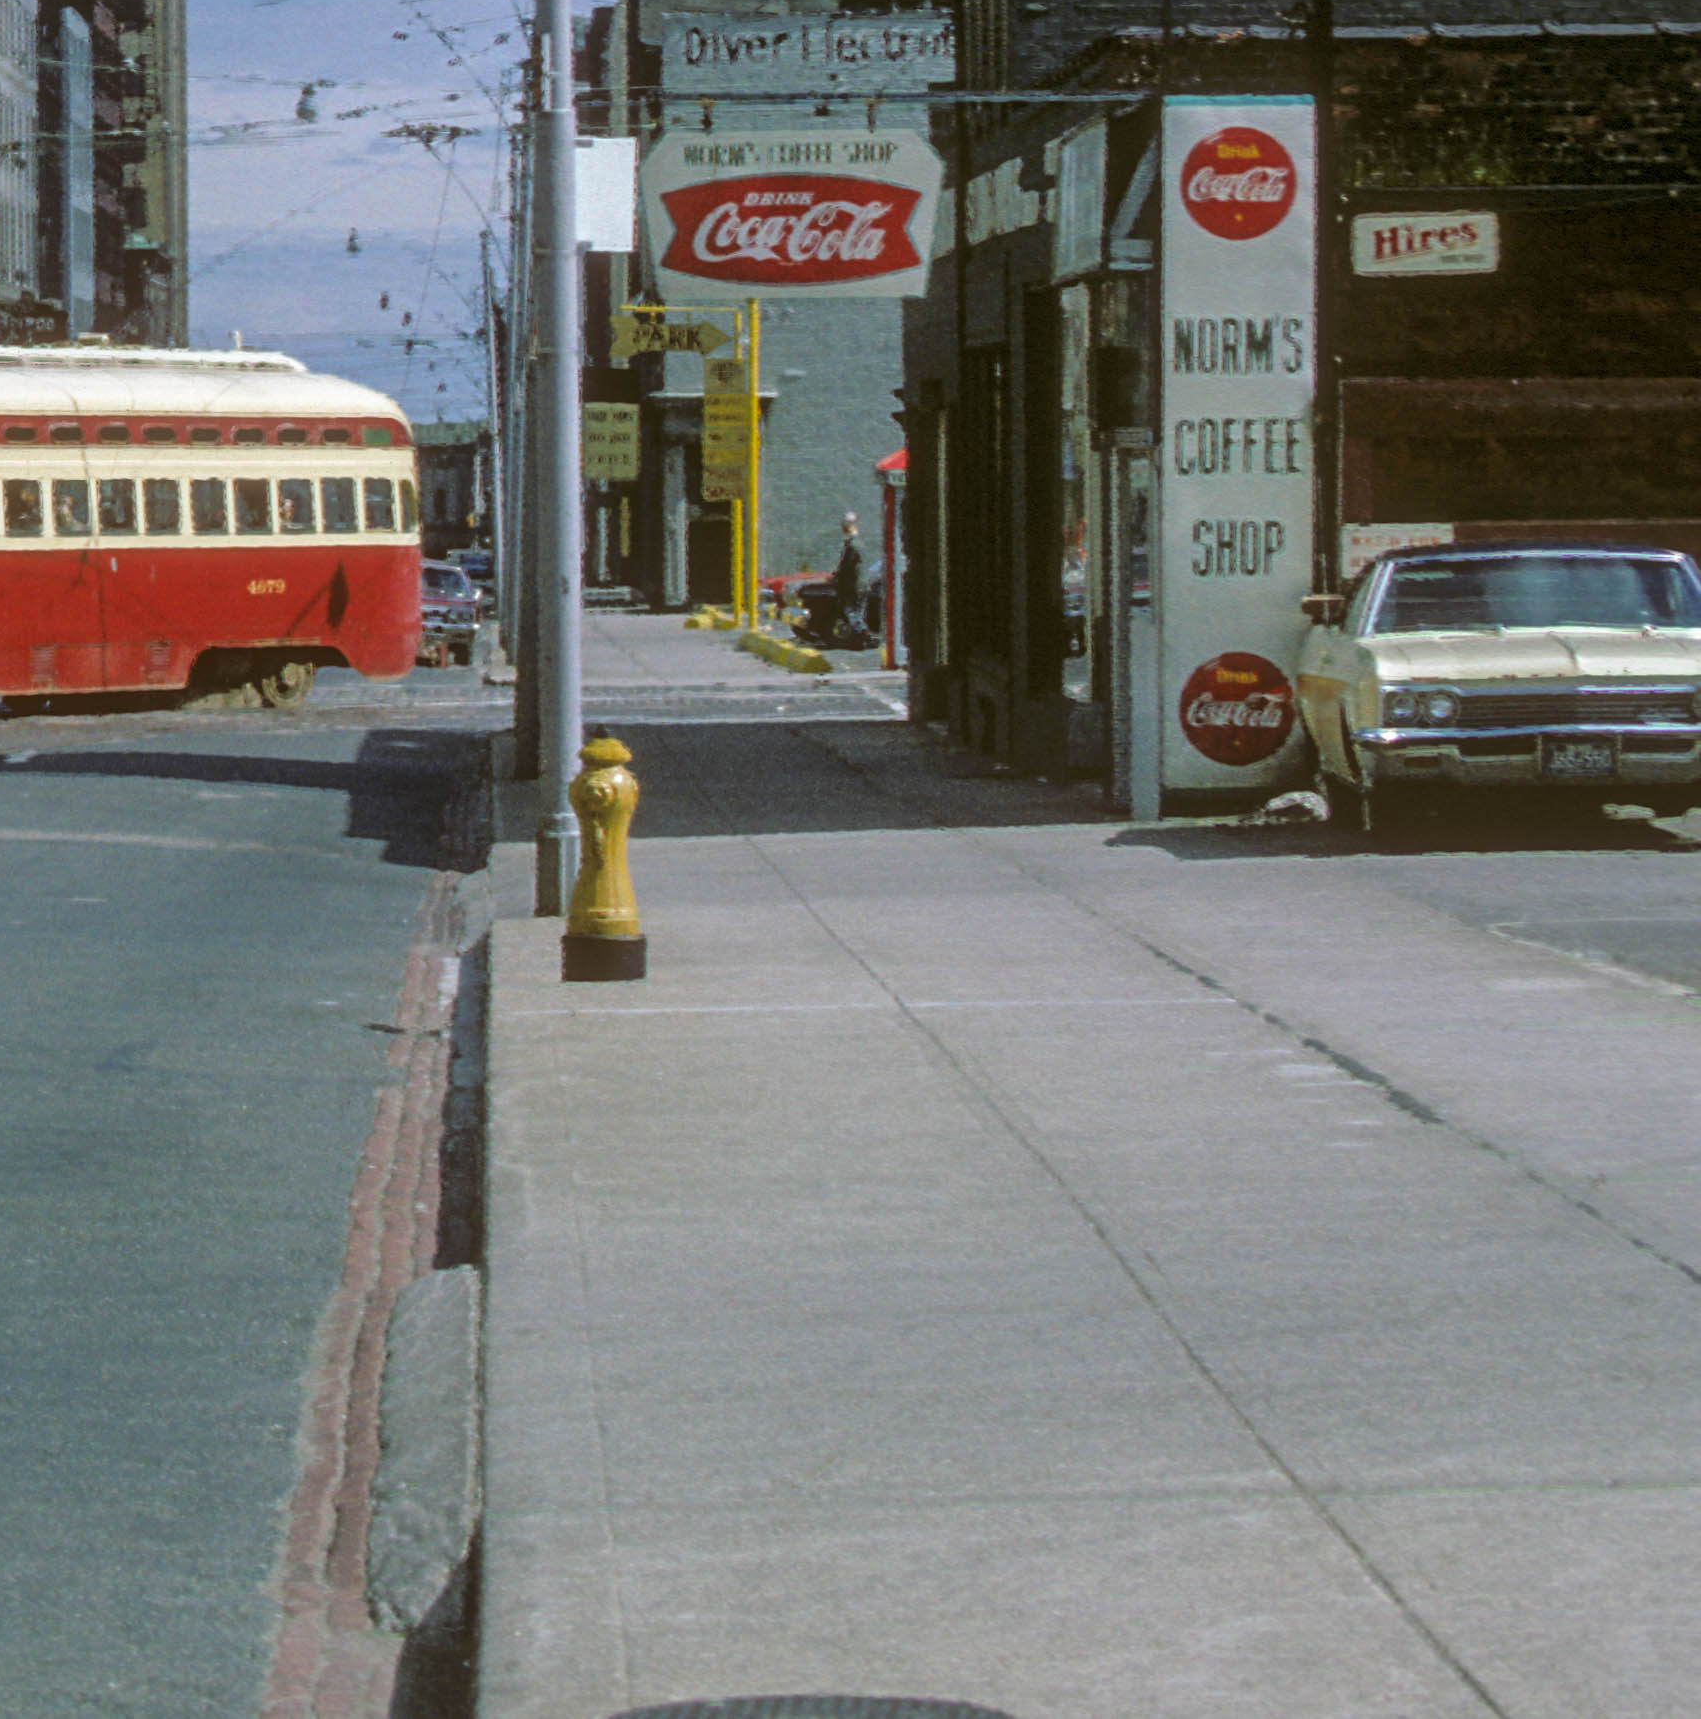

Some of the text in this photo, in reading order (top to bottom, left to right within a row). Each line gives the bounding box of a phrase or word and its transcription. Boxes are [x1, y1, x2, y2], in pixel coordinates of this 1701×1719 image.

[843, 140, 898, 163] SHOP
[742, 191, 815, 206] DRINK
[1373, 221, 1478, 260] Hires
[632, 325, 703, 348] PARK
[1173, 318, 1303, 374] NORM'S
[1174, 418, 1303, 475] COFFEE
[1192, 519, 1285, 577] SHOP
